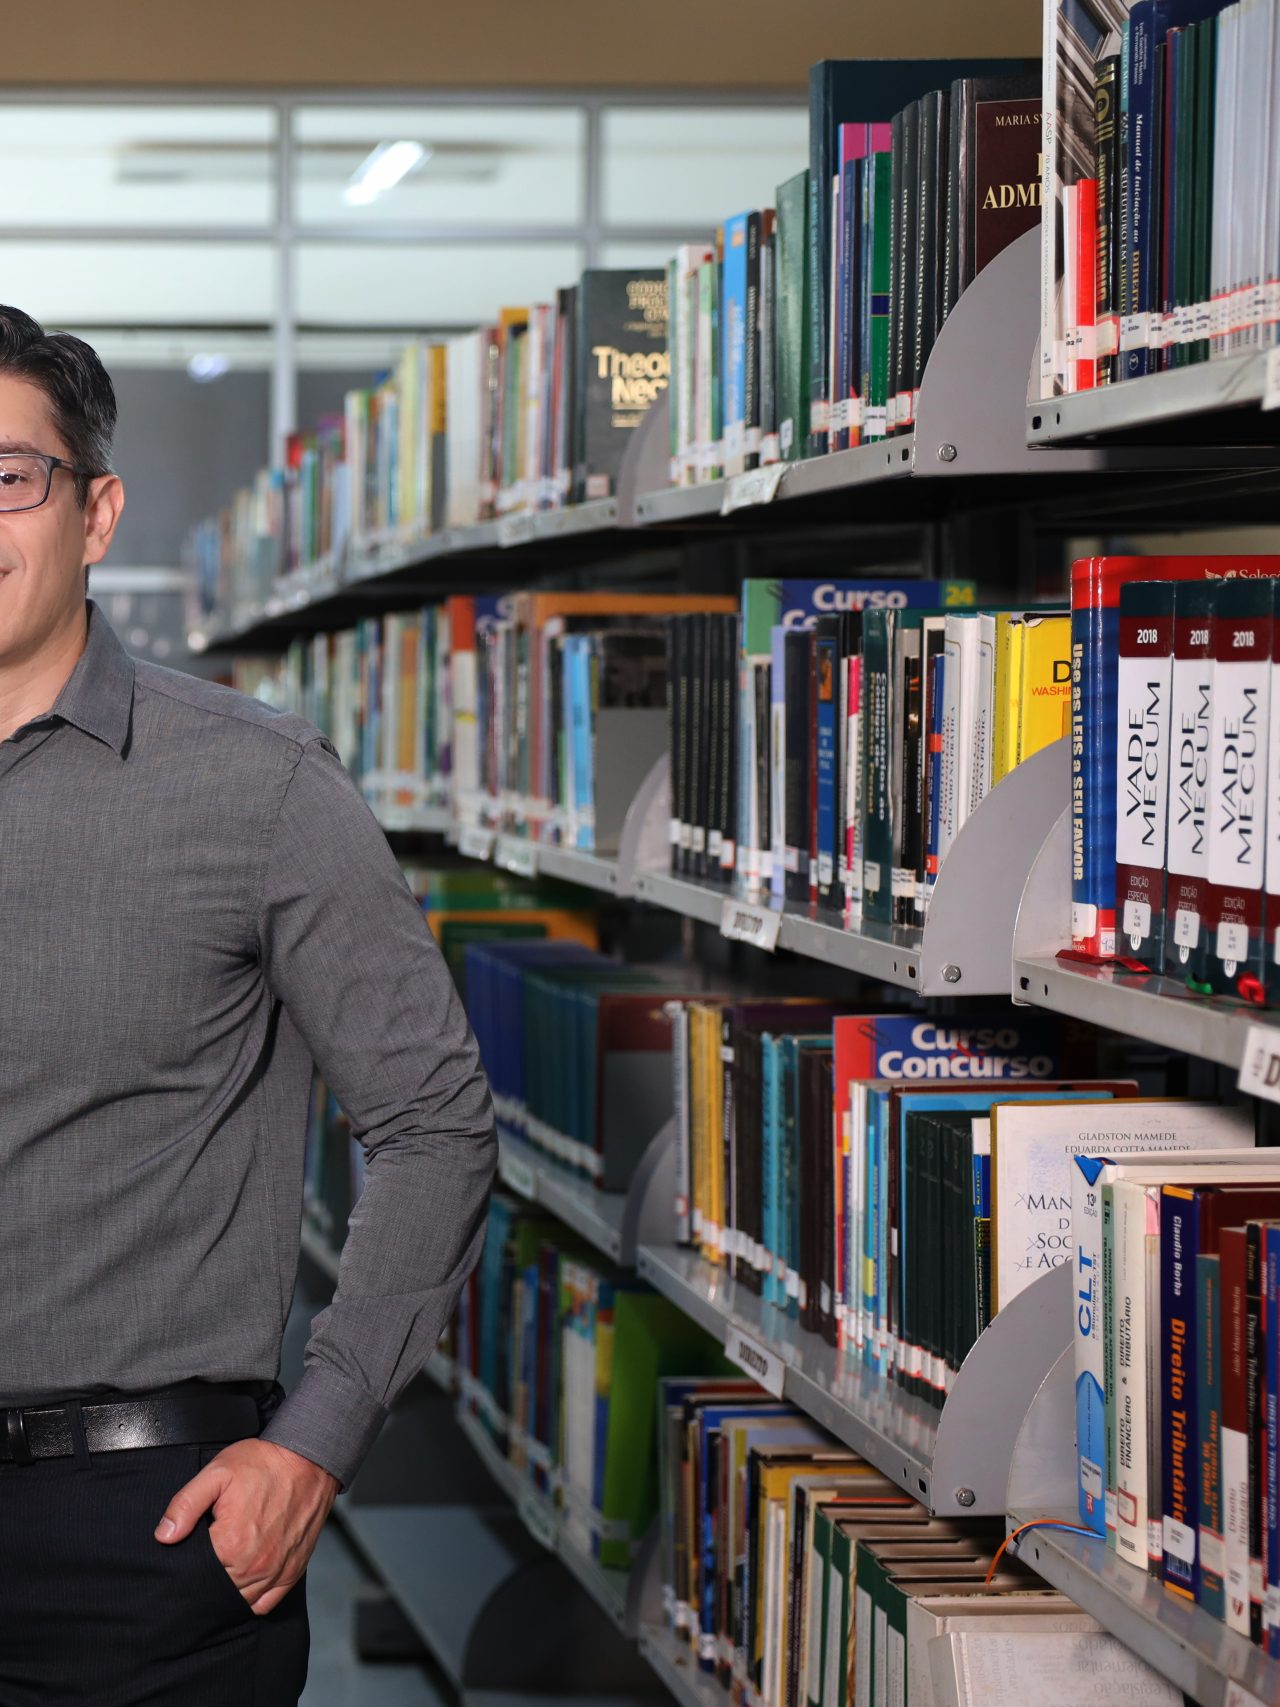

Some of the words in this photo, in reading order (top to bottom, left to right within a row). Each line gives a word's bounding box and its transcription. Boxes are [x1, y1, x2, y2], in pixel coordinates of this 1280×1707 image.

[995, 114, 1031, 127] MARIA
[1045, 111, 1054, 144] AASP
[1135, 113, 1143, 156] Manual
[1134, 159, 1142, 173] de
[919, 181, 927, 241] DIREITO
[1133, 175, 1142, 227] Iniciação
[1121, 244, 1128, 260] EM
[1133, 229, 1139, 243] ao
[1131, 249, 1140, 314] DIREITO
[897, 253, 907, 375] ADMINISTRATIVO
[915, 244, 925, 370] ADMINISTRATIVO
[812, 583, 908, 612] Curso
[945, 584, 976, 607] 24
[1136, 628, 1158, 644] 2018
[1189, 629, 1209, 645] 2018
[1232, 631, 1255, 647] 2018
[1072, 643, 1083, 683] Use
[1072, 686, 1083, 712] as
[879, 671, 887, 792] Comentários
[1072, 715, 1083, 756] LEIS
[874, 743, 880, 768] de
[1072, 759, 1083, 772] a
[1126, 707, 1144, 816] VADE
[1141, 682, 1161, 846] MECUM
[1178, 711, 1196, 825] VADE
[1191, 684, 1211, 855] MECUM
[1220, 715, 1241, 833] VADE
[1073, 776, 1084, 815] SEU
[1236, 688, 1258, 865] MECUM
[879, 796, 885, 821] ao
[1073, 818, 1084, 880] FAVOR
[1127, 890, 1150, 902] ESPECIAL
[1130, 875, 1149, 888] EDIÇÃO
[1180, 885, 1198, 898] EDIÇÃO
[1223, 896, 1246, 910] EDIÇÃO
[910, 1022, 1018, 1050] Curso
[877, 1050, 1054, 1079] Concurso
[1064, 1145, 1111, 1154] EDUARDA
[1113, 1145, 1143, 1153] COTTA
[1078, 1132, 1132, 1141] GLADSTON
[1134, 1132, 1177, 1141] MAMEDE
[1083, 1206, 1098, 1218] EDIÇÃO
[1173, 1215, 1183, 1260] Claudio
[1078, 1244, 1093, 1337] CLT
[1173, 1262, 1183, 1297] Borba
[1124, 1296, 1132, 1369] TRIBUTÁRIO
[1247, 1313, 1257, 1354] Direito
[1171, 1318, 1186, 1400] Direito
[1247, 1358, 1257, 1412] Tributário
[1124, 1395, 1132, 1470] FINANCEIRO
[1267, 1392, 1278, 1449] DIREITO
[1171, 1409, 1187, 1525] Tributário
